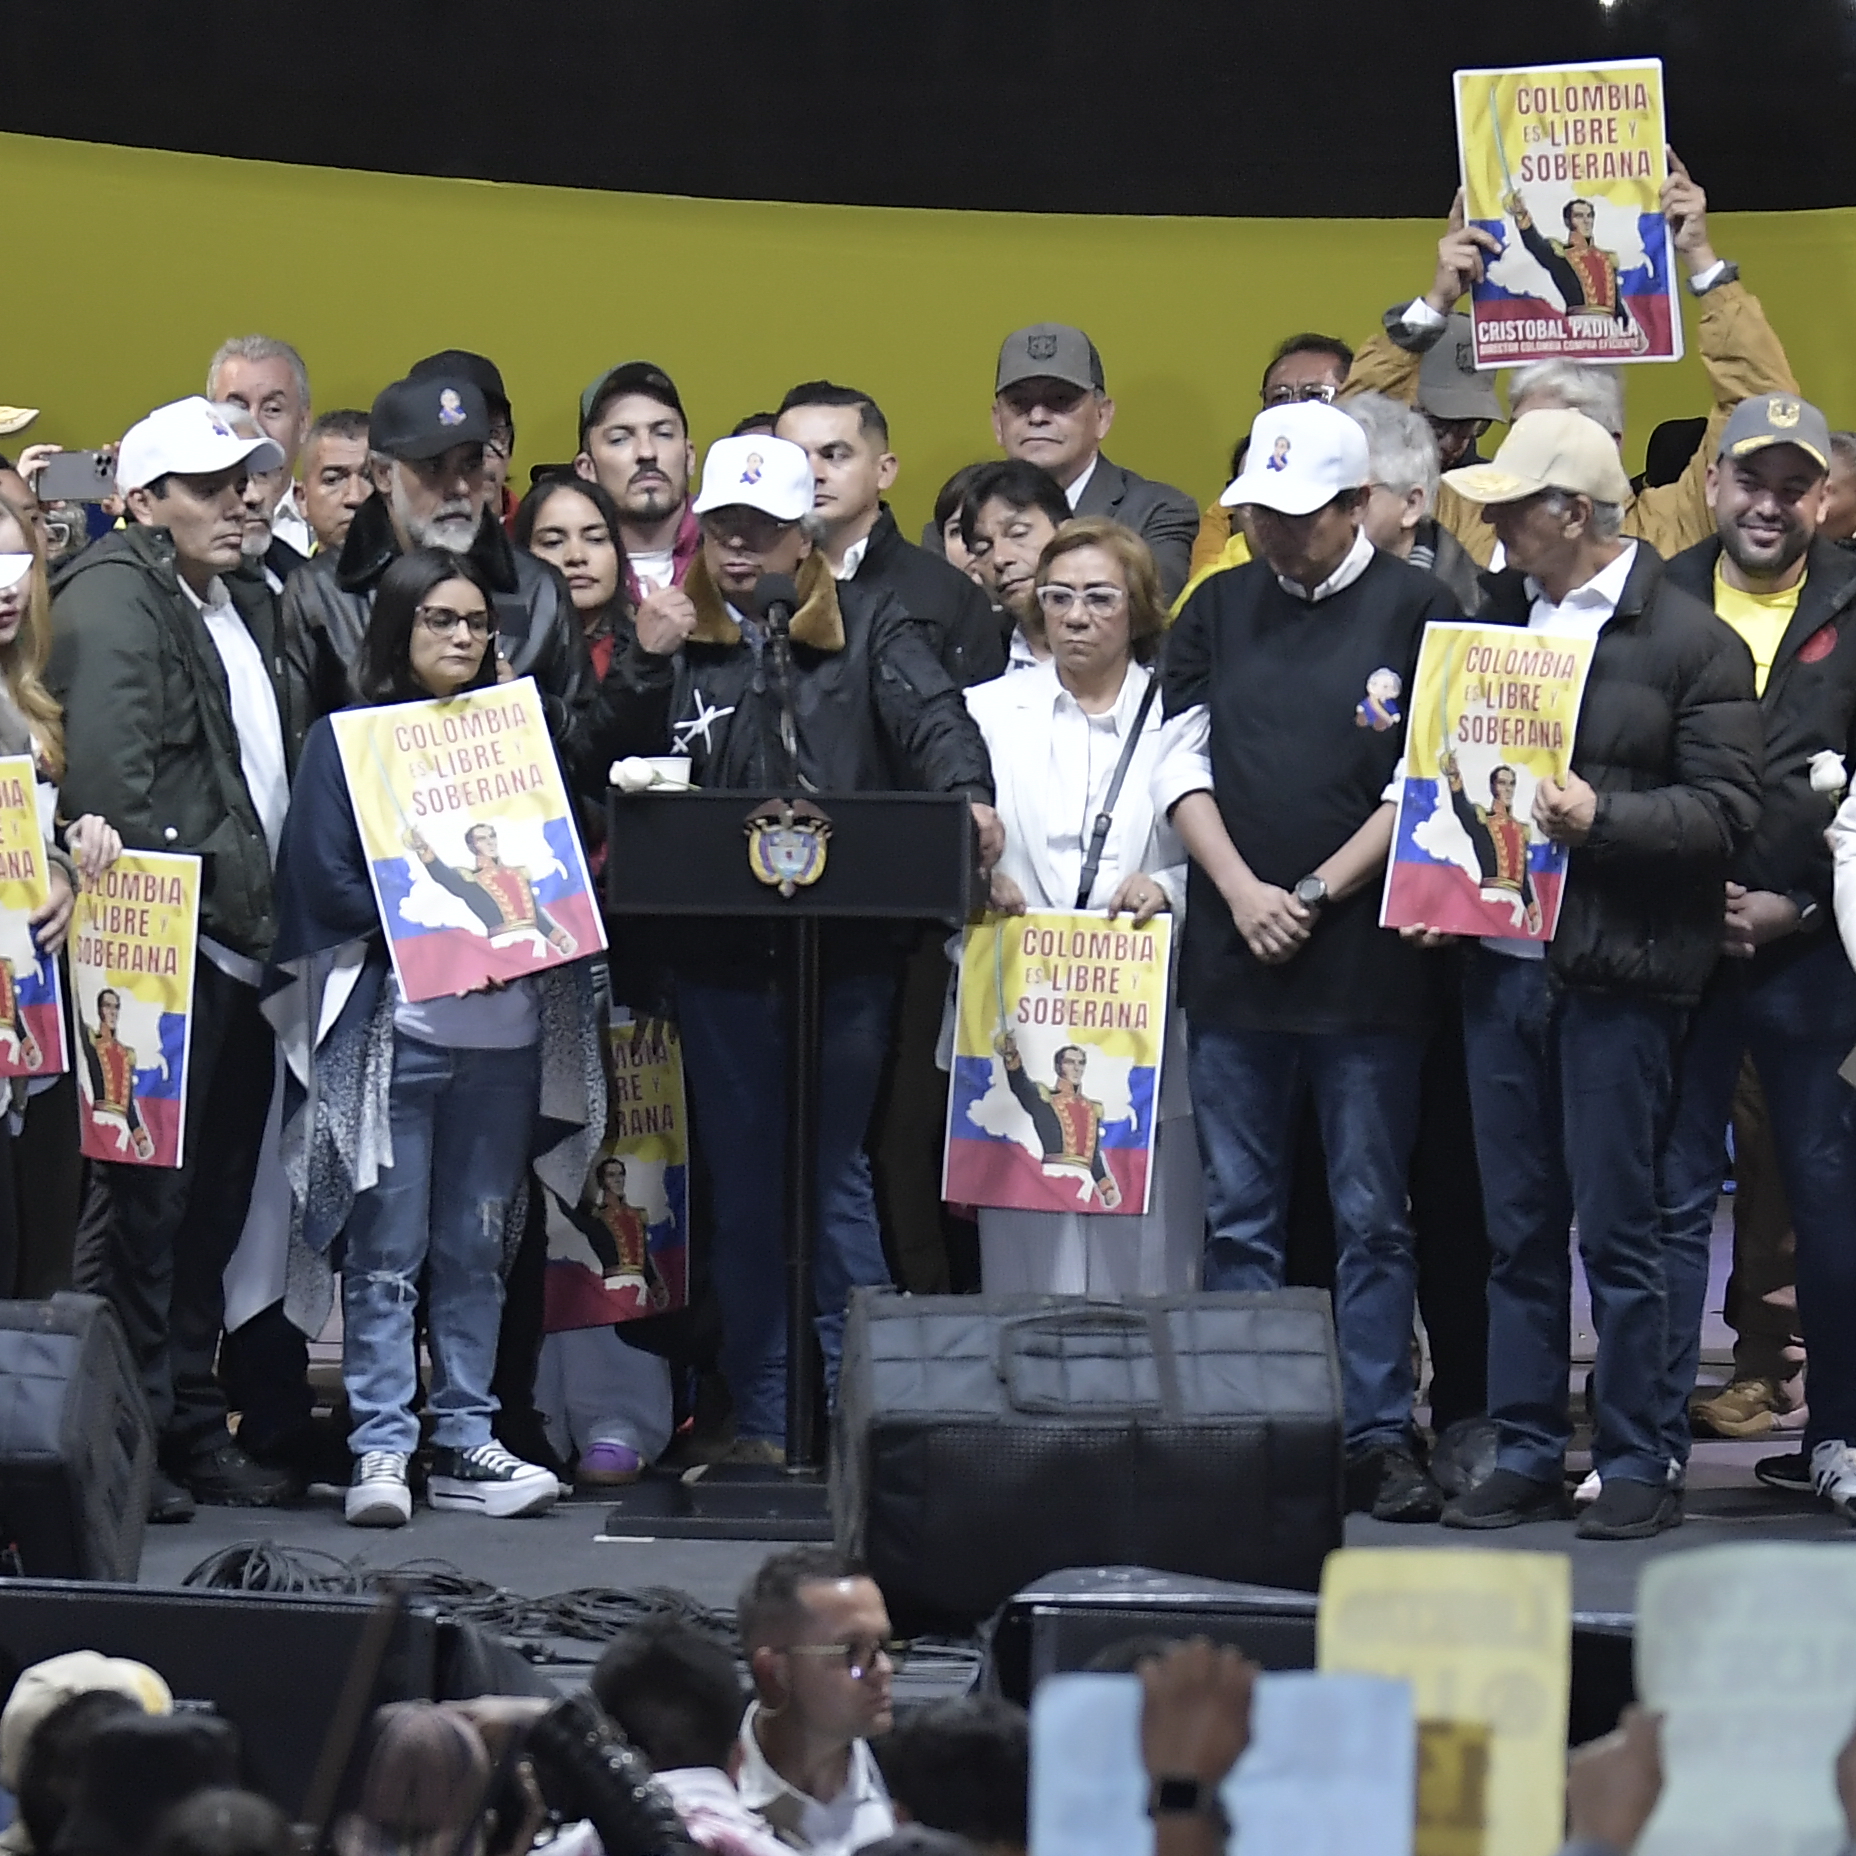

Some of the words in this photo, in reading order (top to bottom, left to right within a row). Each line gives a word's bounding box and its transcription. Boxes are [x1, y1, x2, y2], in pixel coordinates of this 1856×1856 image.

[1517, 83, 1647, 114] COLOMBIA
[1523, 124, 1540, 142] ES
[1550, 118, 1618, 146] LIBRE
[1628, 122, 1636, 139] Y
[1521, 150, 1651, 182] SOBERANA
[1478, 319, 1567, 342] CRISTOBAL
[1571, 317, 1638, 338] PADILLA
[1479, 342, 1519, 356] DIRECTOR
[1520, 340, 1561, 353] COLOMBIA
[1466, 646, 1575, 678] COLOMBIA
[1486, 681, 1542, 711] LIBRE
[395, 703, 526, 752] COLOMBIA
[1458, 714, 1563, 748] SOBERANA
[409, 761, 427, 778] ES
[434, 741, 505, 778] LIBRE
[412, 764, 544, 816] SOBERANA
[93, 903, 150, 937] LIBRE
[1023, 928, 1153, 961] COLOMBIA
[1025, 967, 1043, 984] ES
[1052, 964, 1120, 994] LIBRE
[1017, 996, 1148, 1029] SOBERANA
